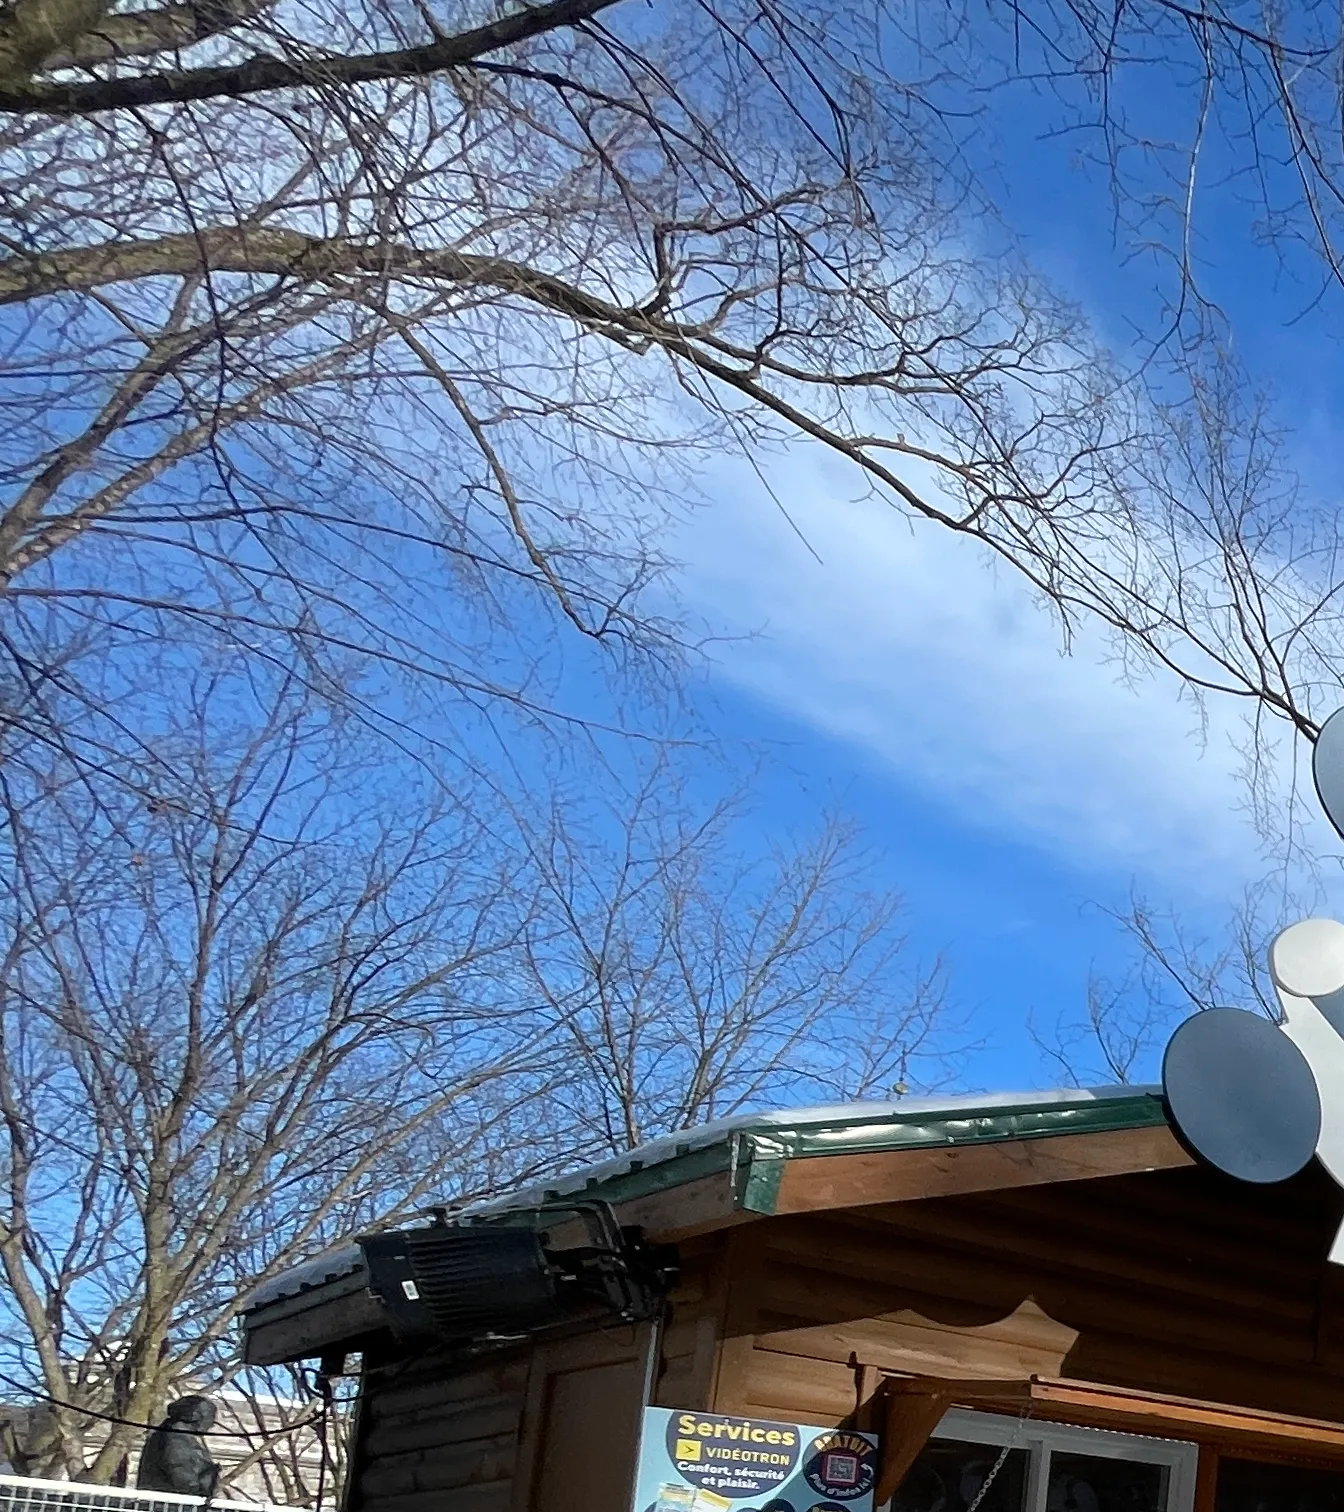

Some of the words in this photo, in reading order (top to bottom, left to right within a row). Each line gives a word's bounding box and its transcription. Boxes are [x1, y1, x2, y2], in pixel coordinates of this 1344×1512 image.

[678, 1415, 795, 1446] Services
[706, 1447, 790, 1466] VIDÉOTRON
[735, 1467, 785, 1480] sécurité
[702, 1476, 716, 1486] et
[717, 1477, 760, 1490] plaisir.
